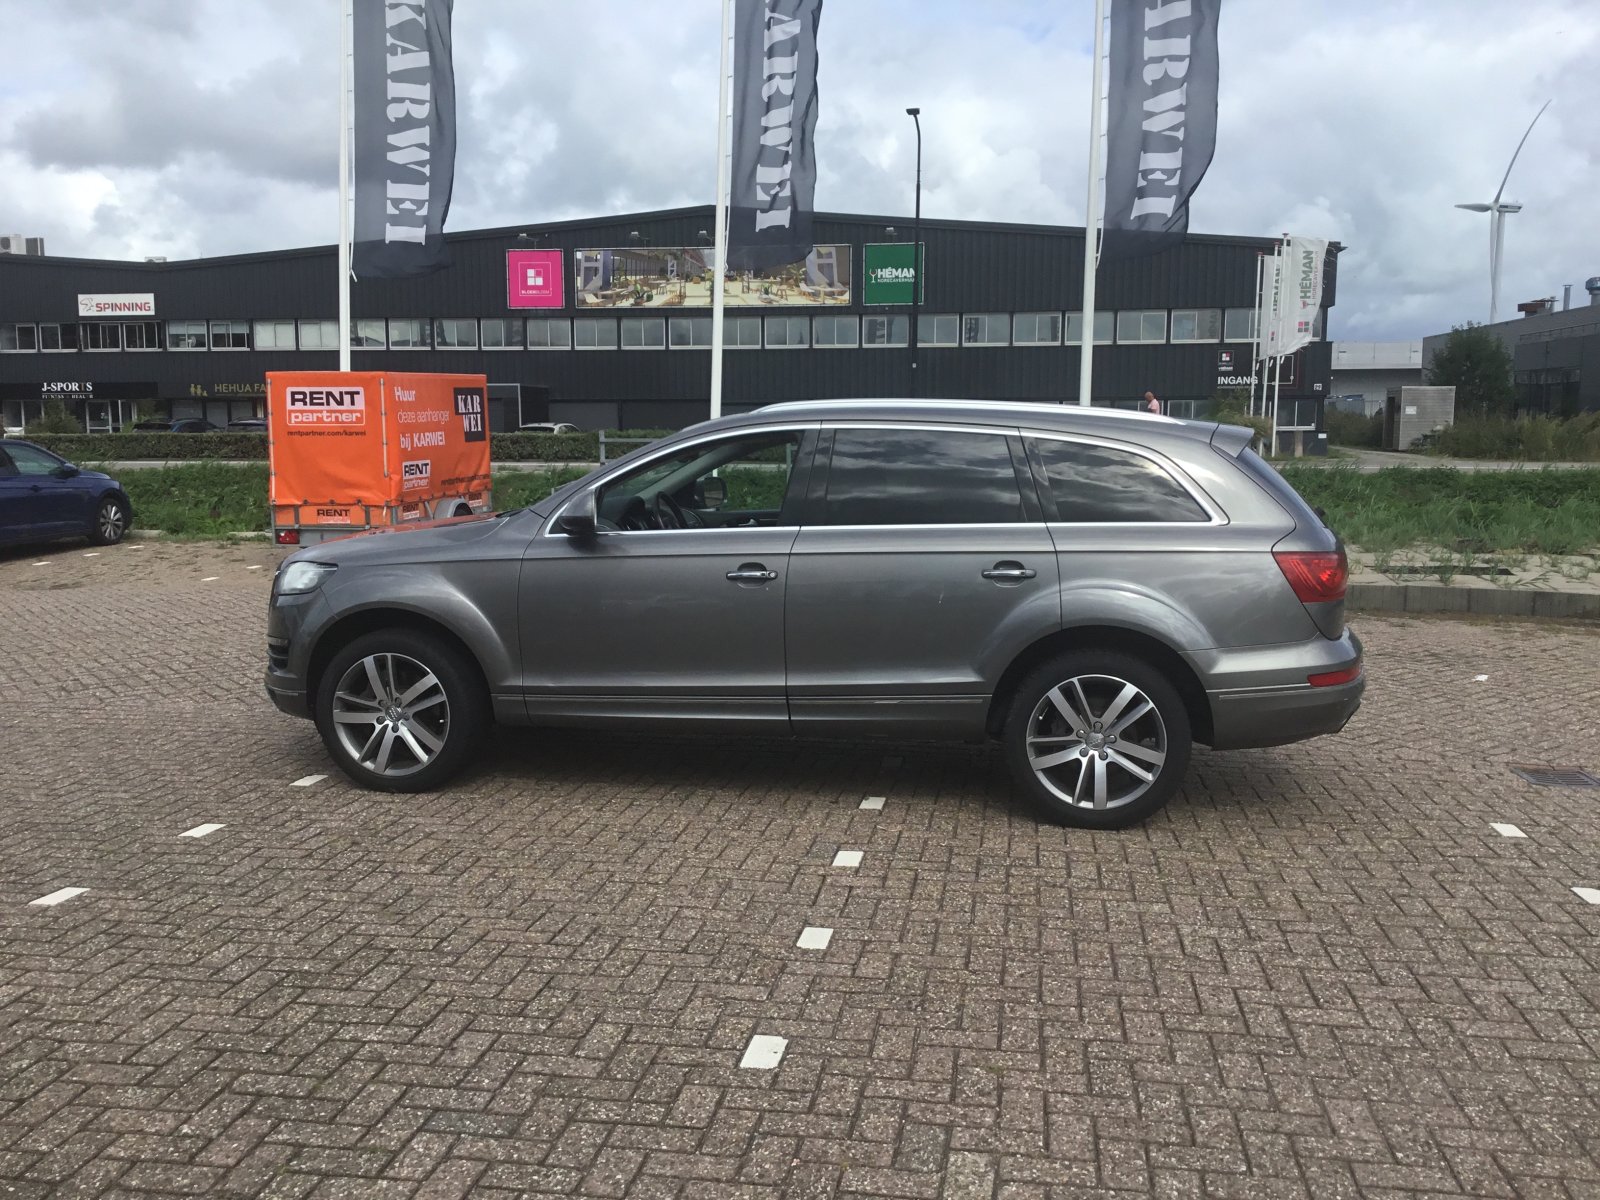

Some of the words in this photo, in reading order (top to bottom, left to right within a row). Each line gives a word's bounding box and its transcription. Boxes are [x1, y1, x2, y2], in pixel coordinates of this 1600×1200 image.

[385, 0, 430, 246] KARWEI
[755, 0, 801, 232] ARWEI
[95, 302, 151, 312] SPINNING
[214, 383, 252, 392] HEHUA
[1217, 376, 1258, 385] INGANG
[290, 391, 360, 406] RENT
[394, 386, 416, 402] Huur
[457, 395, 481, 413] KAR
[291, 410, 361, 423] partner
[397, 409, 416, 423] deze
[416, 408, 450, 424] aanhanger
[462, 414, 482, 432] WEI
[400, 433, 411, 451] bij
[413, 431, 446, 447] KARWEI
[404, 463, 429, 477] RENT
[404, 478, 429, 489] partner
[316, 509, 350, 517] RENT
